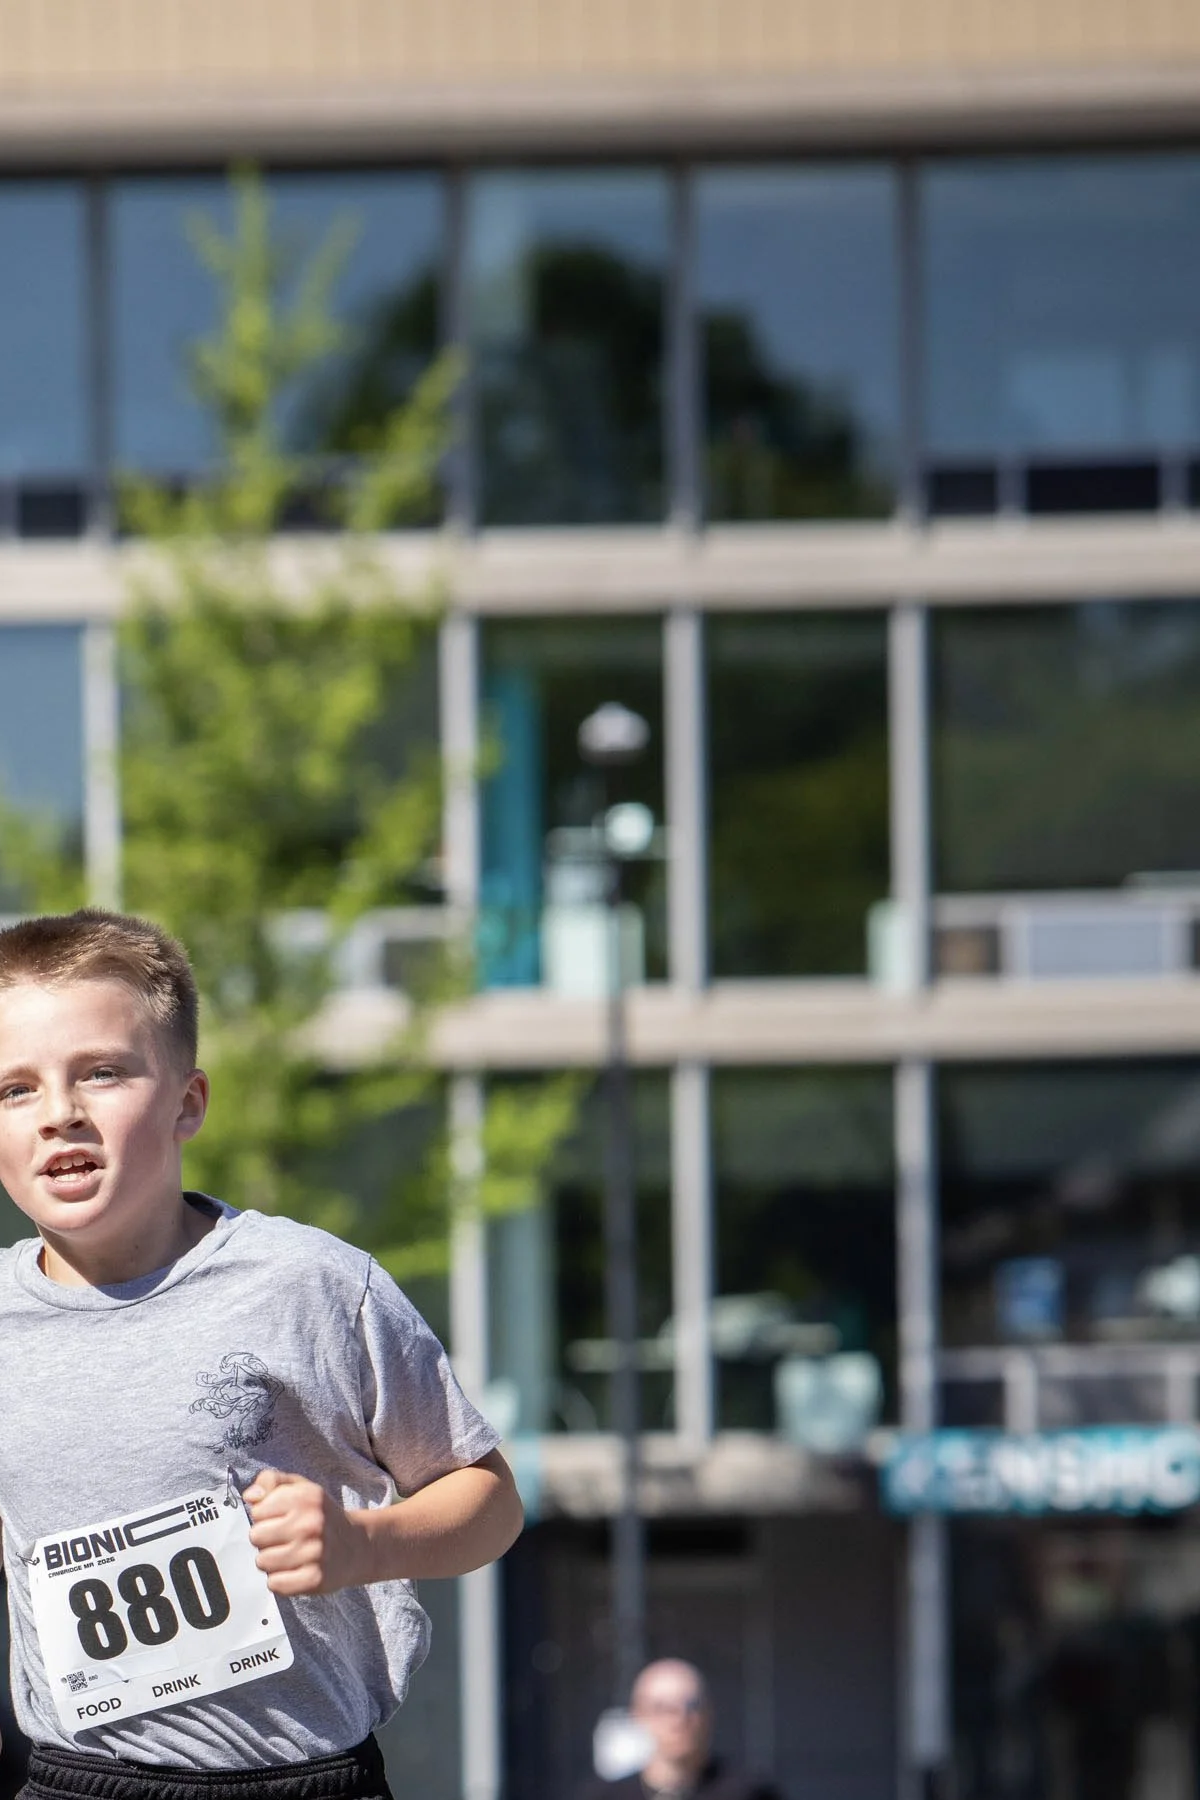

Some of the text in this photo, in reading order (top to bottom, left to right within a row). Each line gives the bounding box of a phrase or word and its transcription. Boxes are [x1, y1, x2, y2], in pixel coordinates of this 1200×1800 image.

[43, 1504, 191, 1570] BIONIC
[48, 1565, 83, 1579] CAMBRIDGE
[68, 1546, 231, 1661] 880
[76, 1647, 281, 1720] FOOD DRINK DRINK
